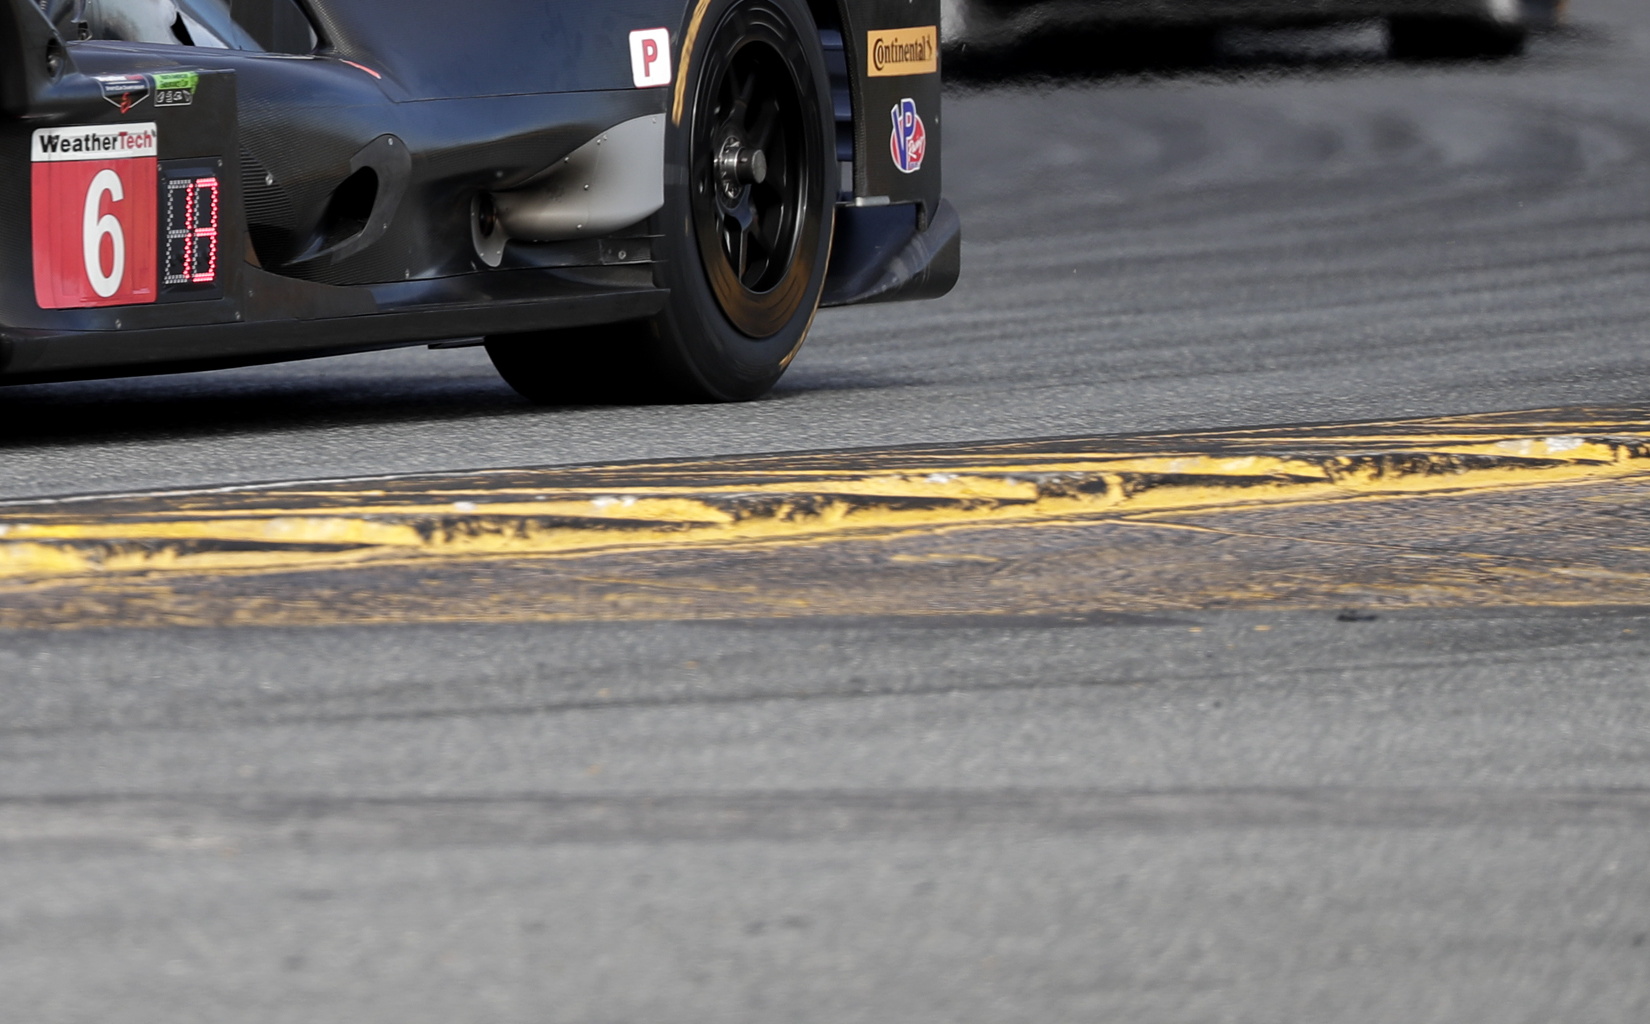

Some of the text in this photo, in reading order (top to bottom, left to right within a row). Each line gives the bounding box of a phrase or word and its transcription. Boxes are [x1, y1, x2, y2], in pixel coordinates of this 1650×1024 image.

[642, 38, 658, 77] P
[873, 36, 926, 72] Continental
[40, 130, 153, 153] WeatherTech
[83, 169, 125, 297] 6
